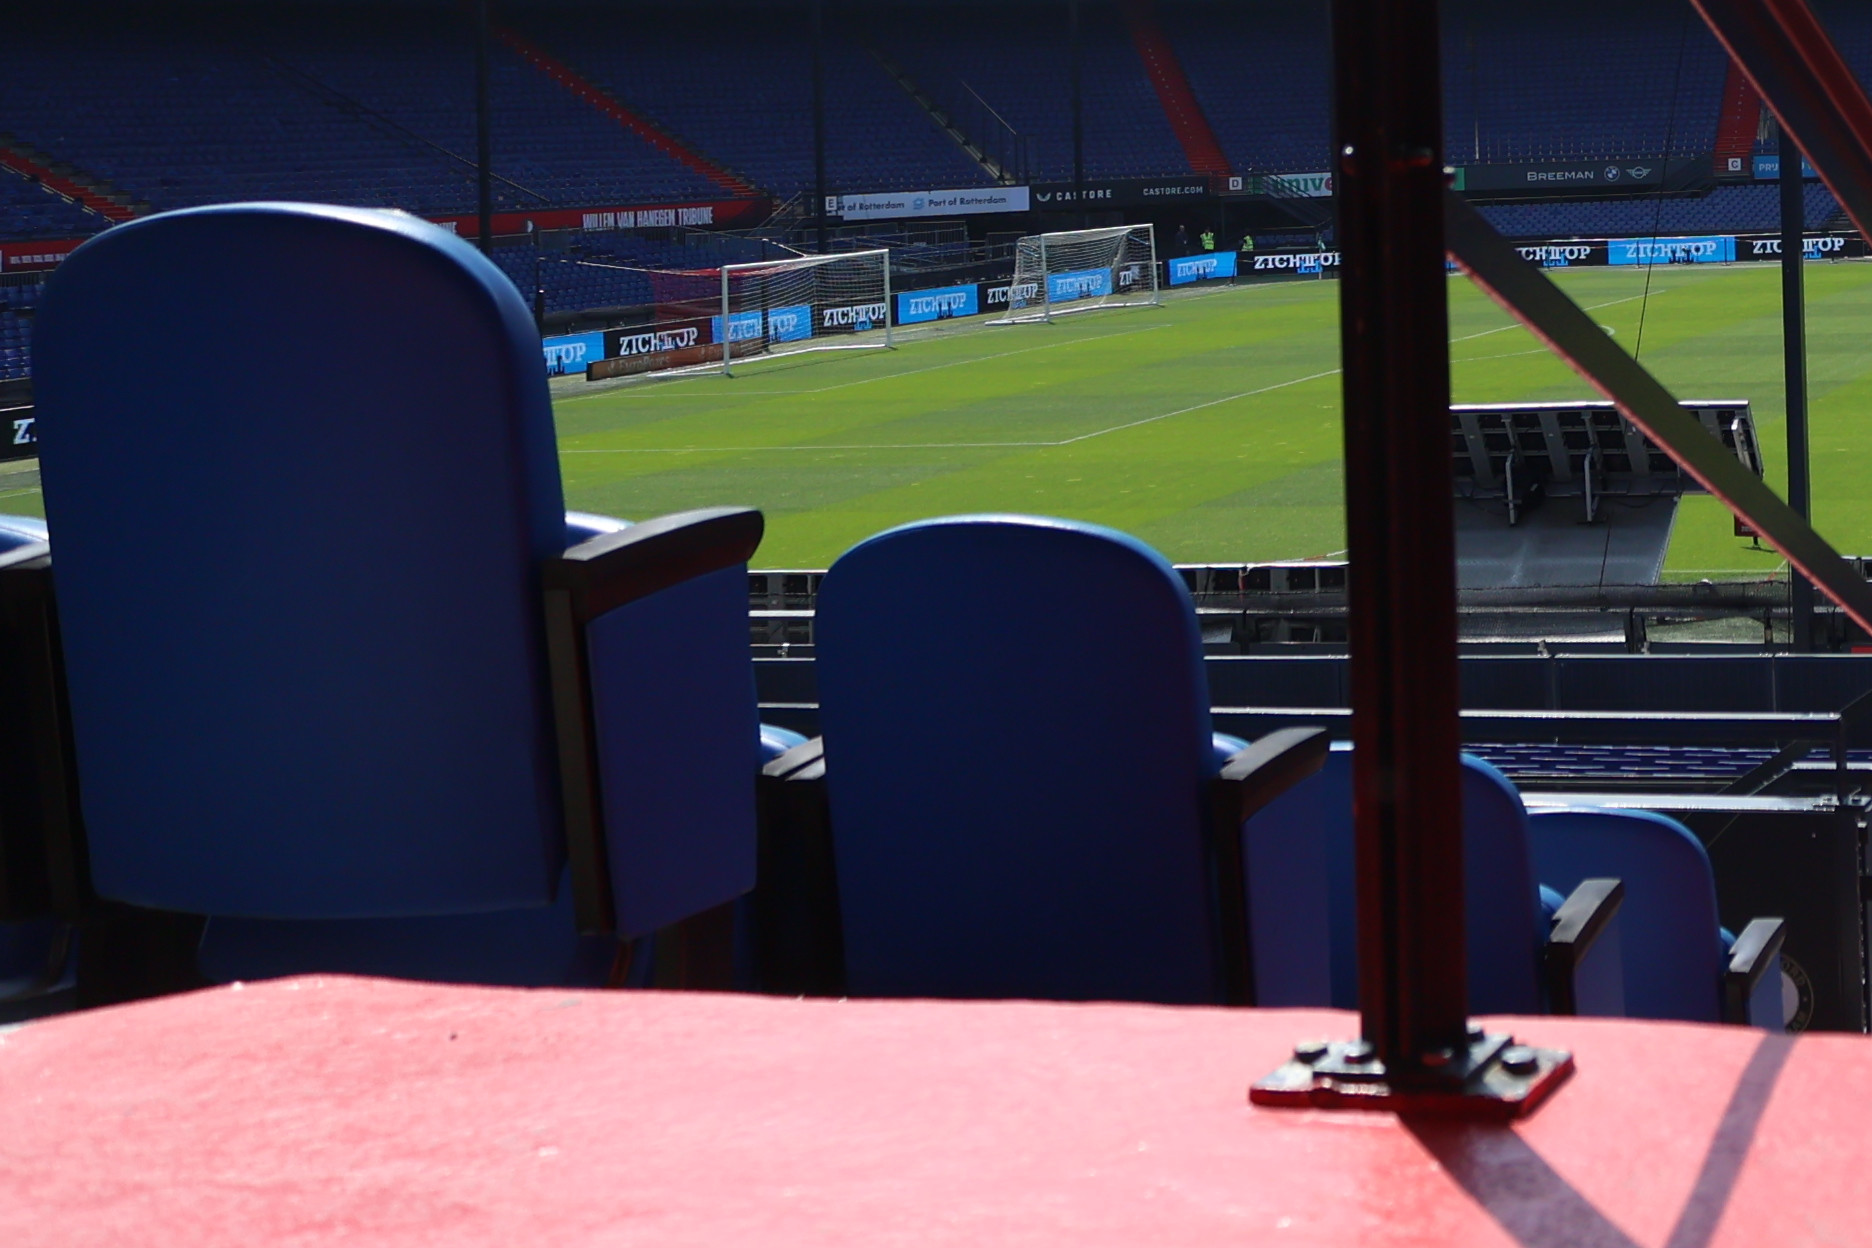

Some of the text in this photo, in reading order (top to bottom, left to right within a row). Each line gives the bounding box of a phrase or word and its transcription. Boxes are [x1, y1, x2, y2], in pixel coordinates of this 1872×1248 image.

[1527, 170, 1594, 182] BREEMAN
[1143, 185, 1203, 196] CASTORE.COM
[847, 202, 857, 211] of
[859, 201, 905, 212] Rotterdam
[928, 195, 1007, 208] Port of Rotterdam
[616, 212, 635, 228] VAN
[677, 206, 714, 226] TRIBUNE
